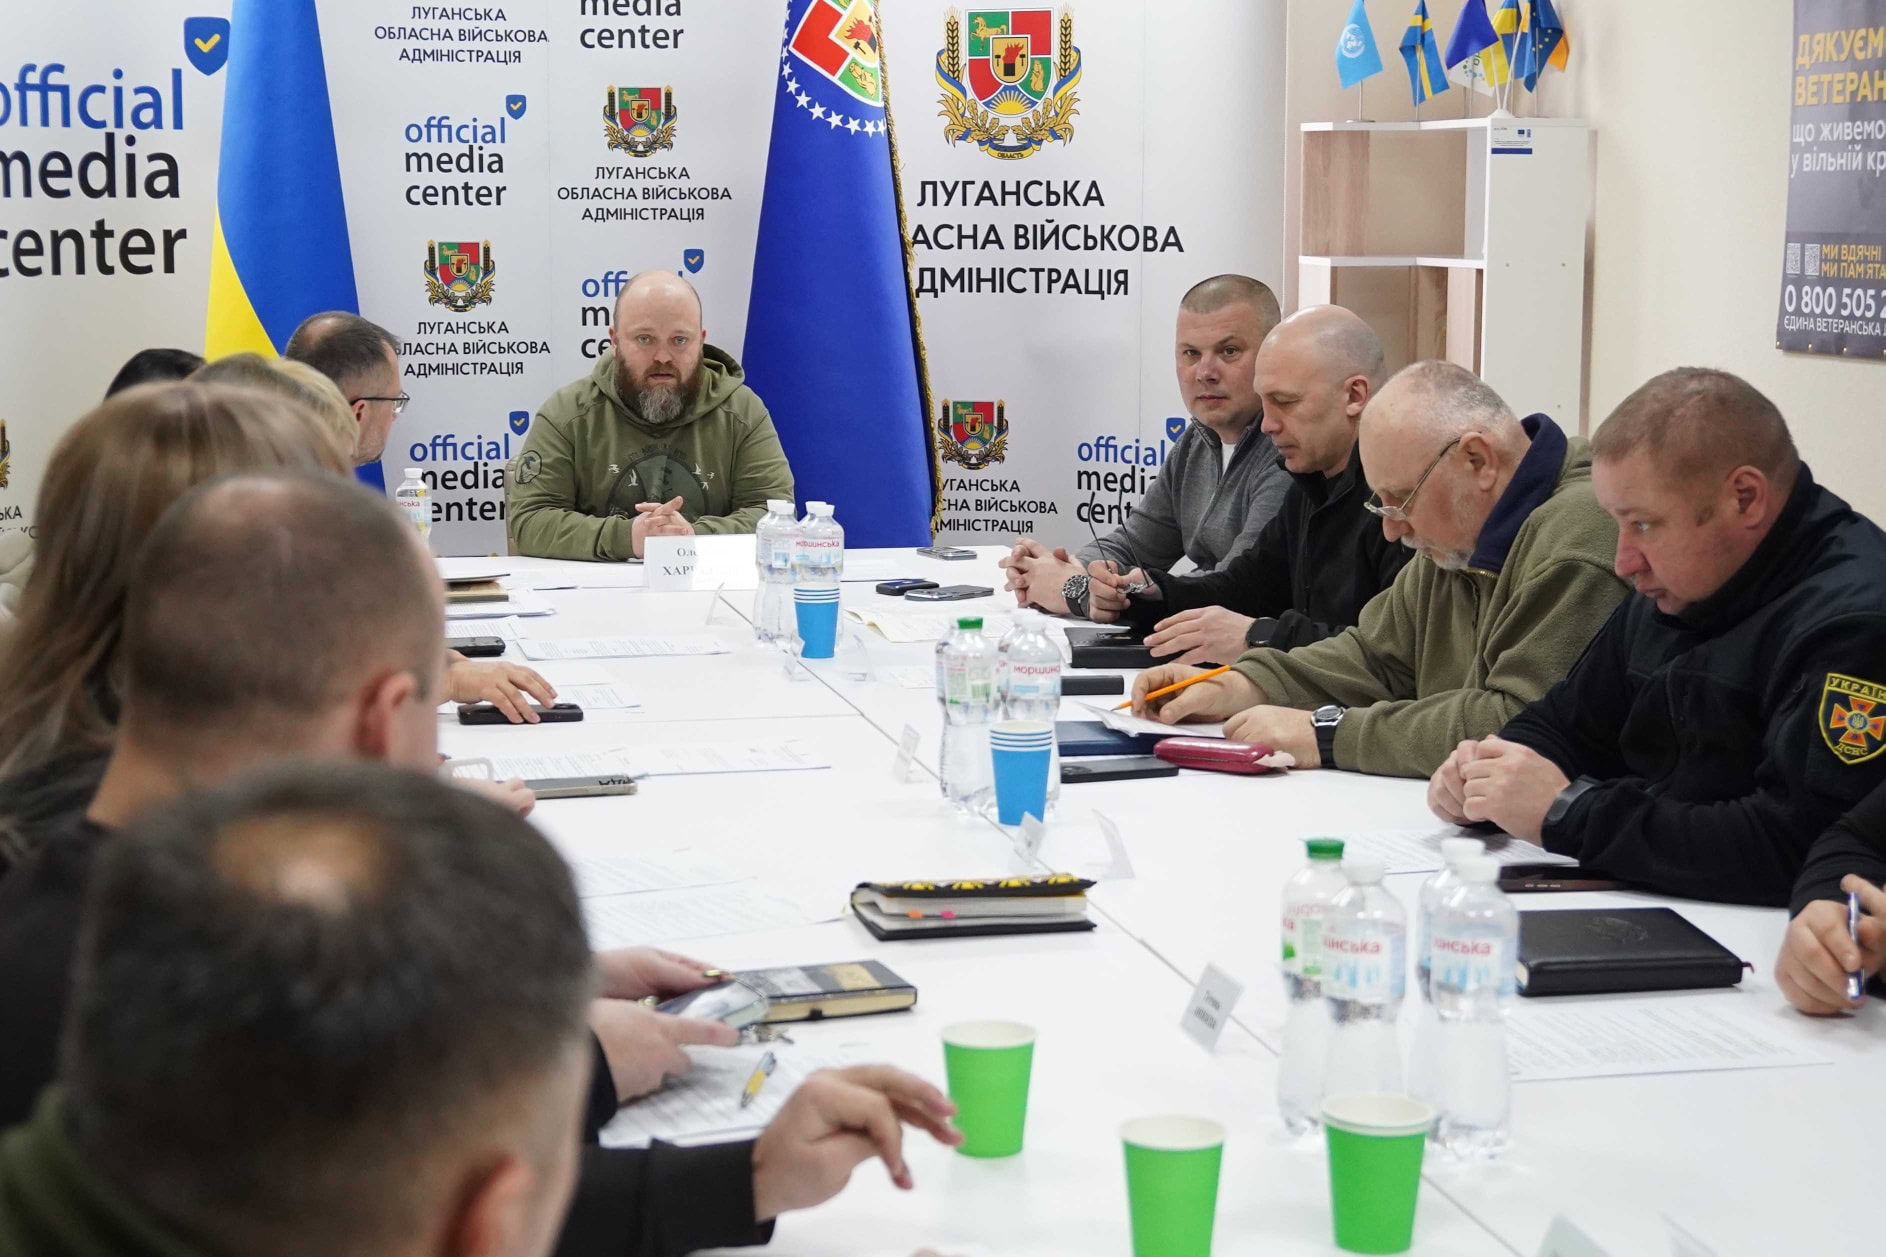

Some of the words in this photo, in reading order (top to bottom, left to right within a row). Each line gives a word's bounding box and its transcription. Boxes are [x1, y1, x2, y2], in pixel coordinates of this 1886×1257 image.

[411, 6, 507, 21] ЛУГАНСЬКА
[374, 26, 454, 41] ОБЛАСНА
[458, 26, 550, 43] ВІЙСЬКОВА
[580, 24, 684, 49] center
[399, 48, 522, 65] АДМІНІСТРАЦІЯ
[1795, 26, 1886, 71] ДЯКУЄМ
[405, 116, 506, 144] official
[1792, 123, 1815, 147] що
[1819, 119, 1886, 142] живемо
[405, 145, 504, 174] media
[1790, 153, 1800, 179] у
[1802, 144, 1862, 172] вільній
[595, 165, 690, 180] ЛУГАНСЬКА
[405, 181, 507, 206] center
[557, 186, 638, 200] ОБЛАСНА
[642, 185, 733, 201] ВІЙСЬКОВА
[916, 180, 1105, 207] ЛУГАНСЬКА
[581, 206, 705, 222] АДМІНІСТРАЦІЯ
[911, 223, 1004, 250] АСНА
[1013, 219, 1185, 253] ВІЙСЬКОВА
[1822, 244, 1839, 260] МИ
[1841, 244, 1882, 263] ВДЯЧНІ
[1821, 261, 1838, 277] МИ
[915, 266, 1129, 300] ДМІНІСТРАЦІЯ
[1784, 284, 1796, 312] 0
[1801, 285, 1837, 315] 800
[1840, 287, 1875, 318] 505
[417, 321, 509, 335] ЛУГАНСЬКА
[1784, 315, 1815, 331] ЄДИНА
[1816, 317, 1881, 336] ВЕТЕРАНСЬКА
[396, 341, 459, 356] ЛАСНА
[463, 339, 551, 355] ВІЙСЬКОВА
[404, 362, 524, 378] АДМІНІСТРАЦІЯ
[409, 433, 510, 462] official
[1077, 436, 1165, 466] official
[942, 479, 1021, 492] УГАНСЬКА
[1077, 465, 1158, 495] medi
[975, 496, 1058, 514] ВІЙСЬКОВА
[1077, 501, 1132, 525] cent
[935, 518, 1034, 535] МІНІСТРАЦІЯ
